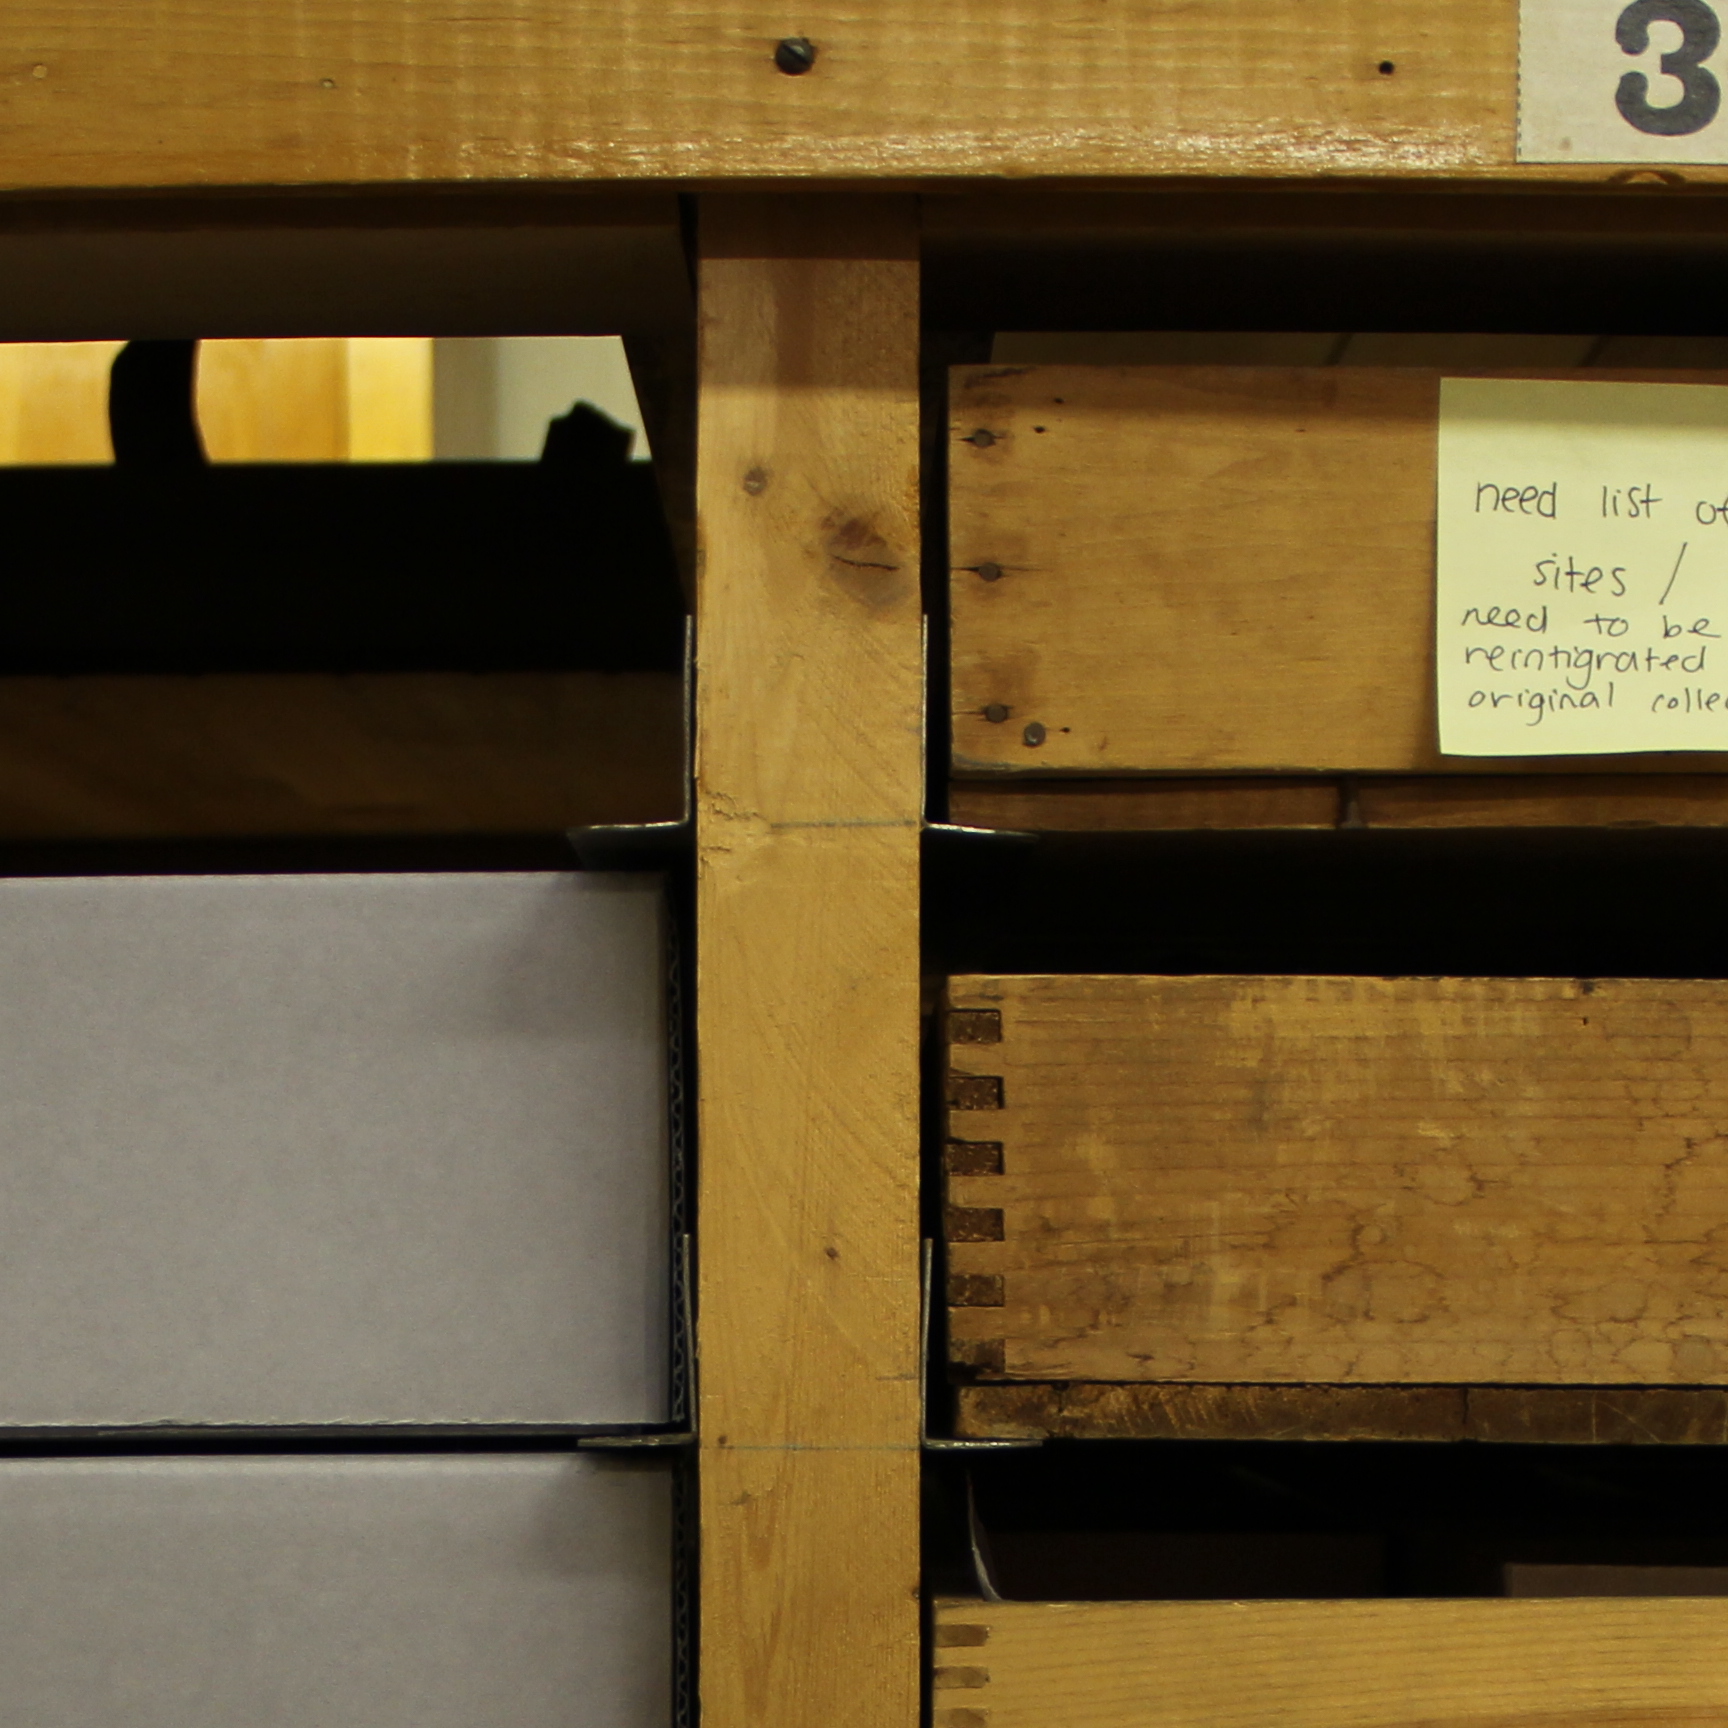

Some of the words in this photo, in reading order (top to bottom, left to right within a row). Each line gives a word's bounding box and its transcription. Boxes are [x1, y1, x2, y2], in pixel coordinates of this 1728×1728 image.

[1475, 481, 1558, 519] need
[1602, 485, 1663, 518] list
[1534, 553, 1627, 597] sites
[1461, 606, 1548, 633] need
[1584, 614, 1629, 636] to
[1663, 615, 1722, 639] be
[1468, 682, 1615, 726] original
